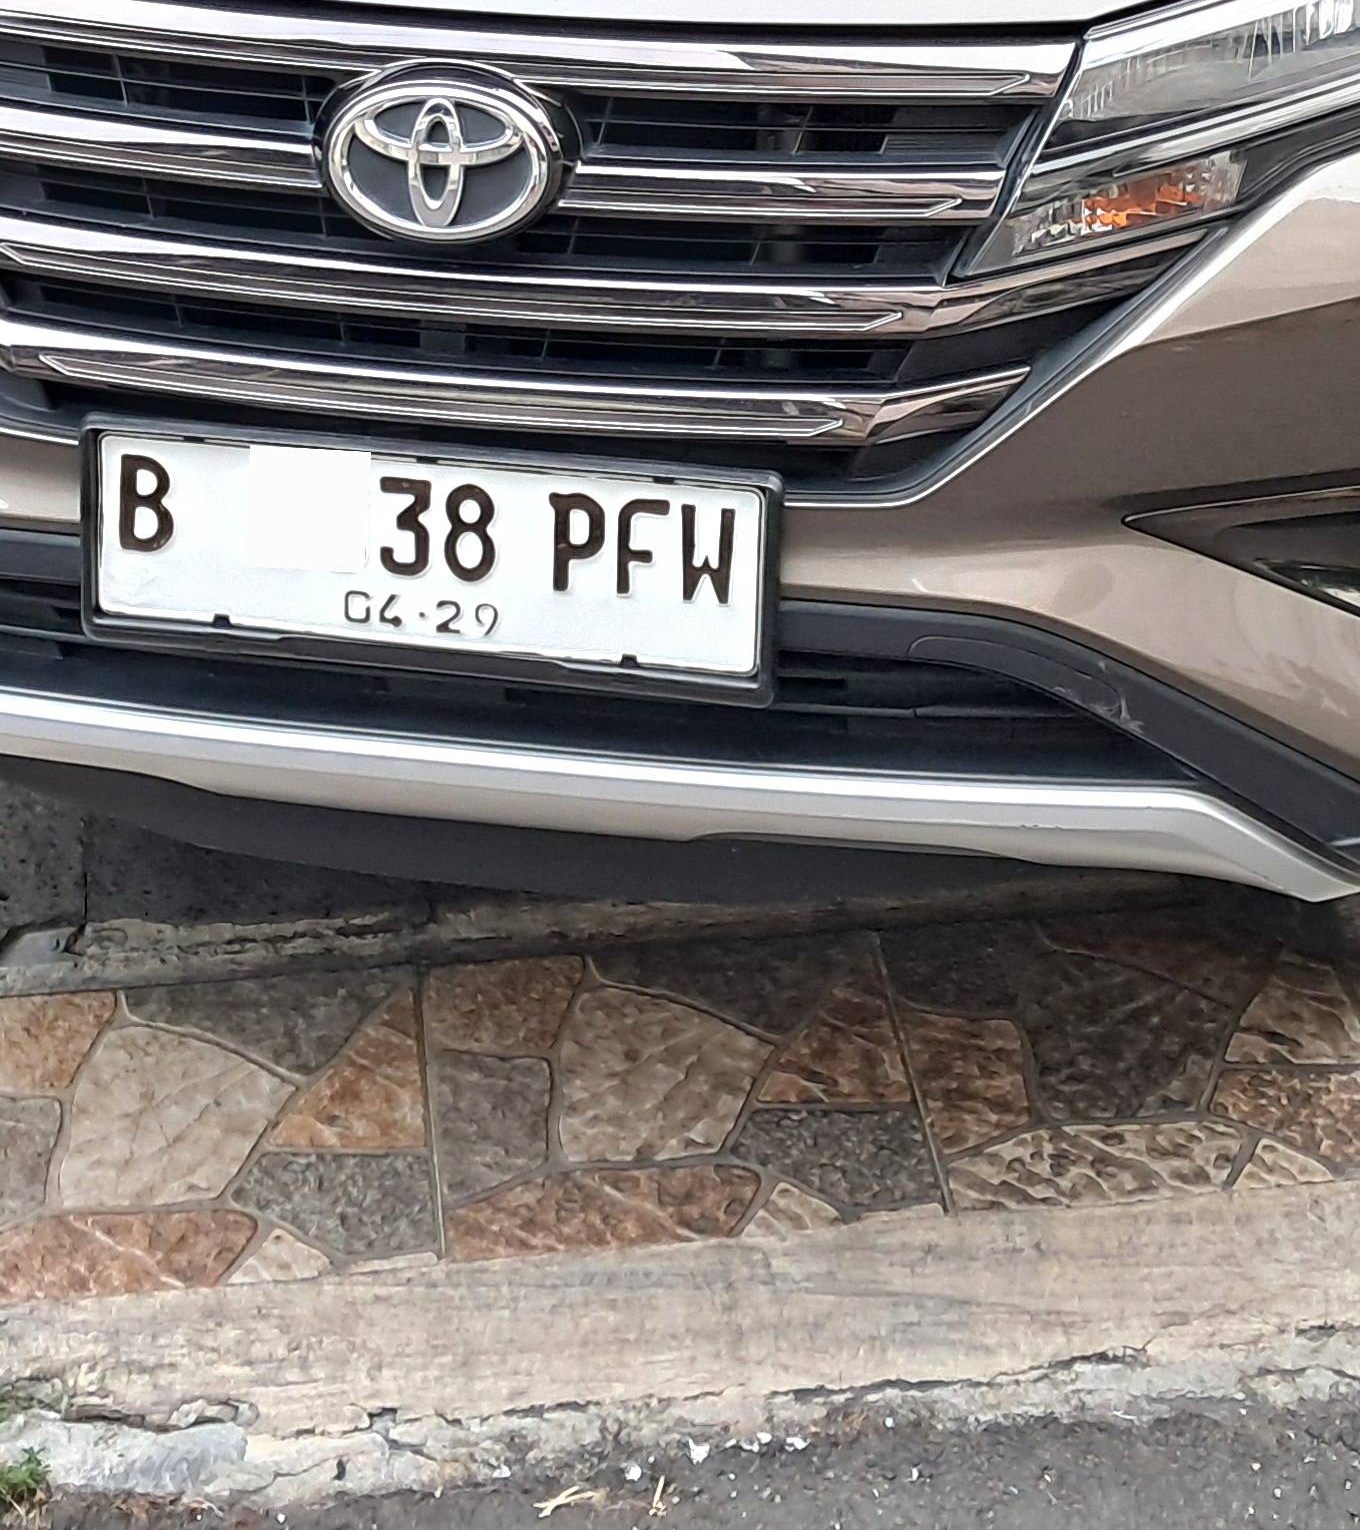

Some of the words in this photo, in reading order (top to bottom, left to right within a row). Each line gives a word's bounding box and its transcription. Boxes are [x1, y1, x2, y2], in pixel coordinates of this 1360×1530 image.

[118, 453, 175, 553] B
[379, 475, 496, 583] 38
[548, 491, 736, 606] PFW
